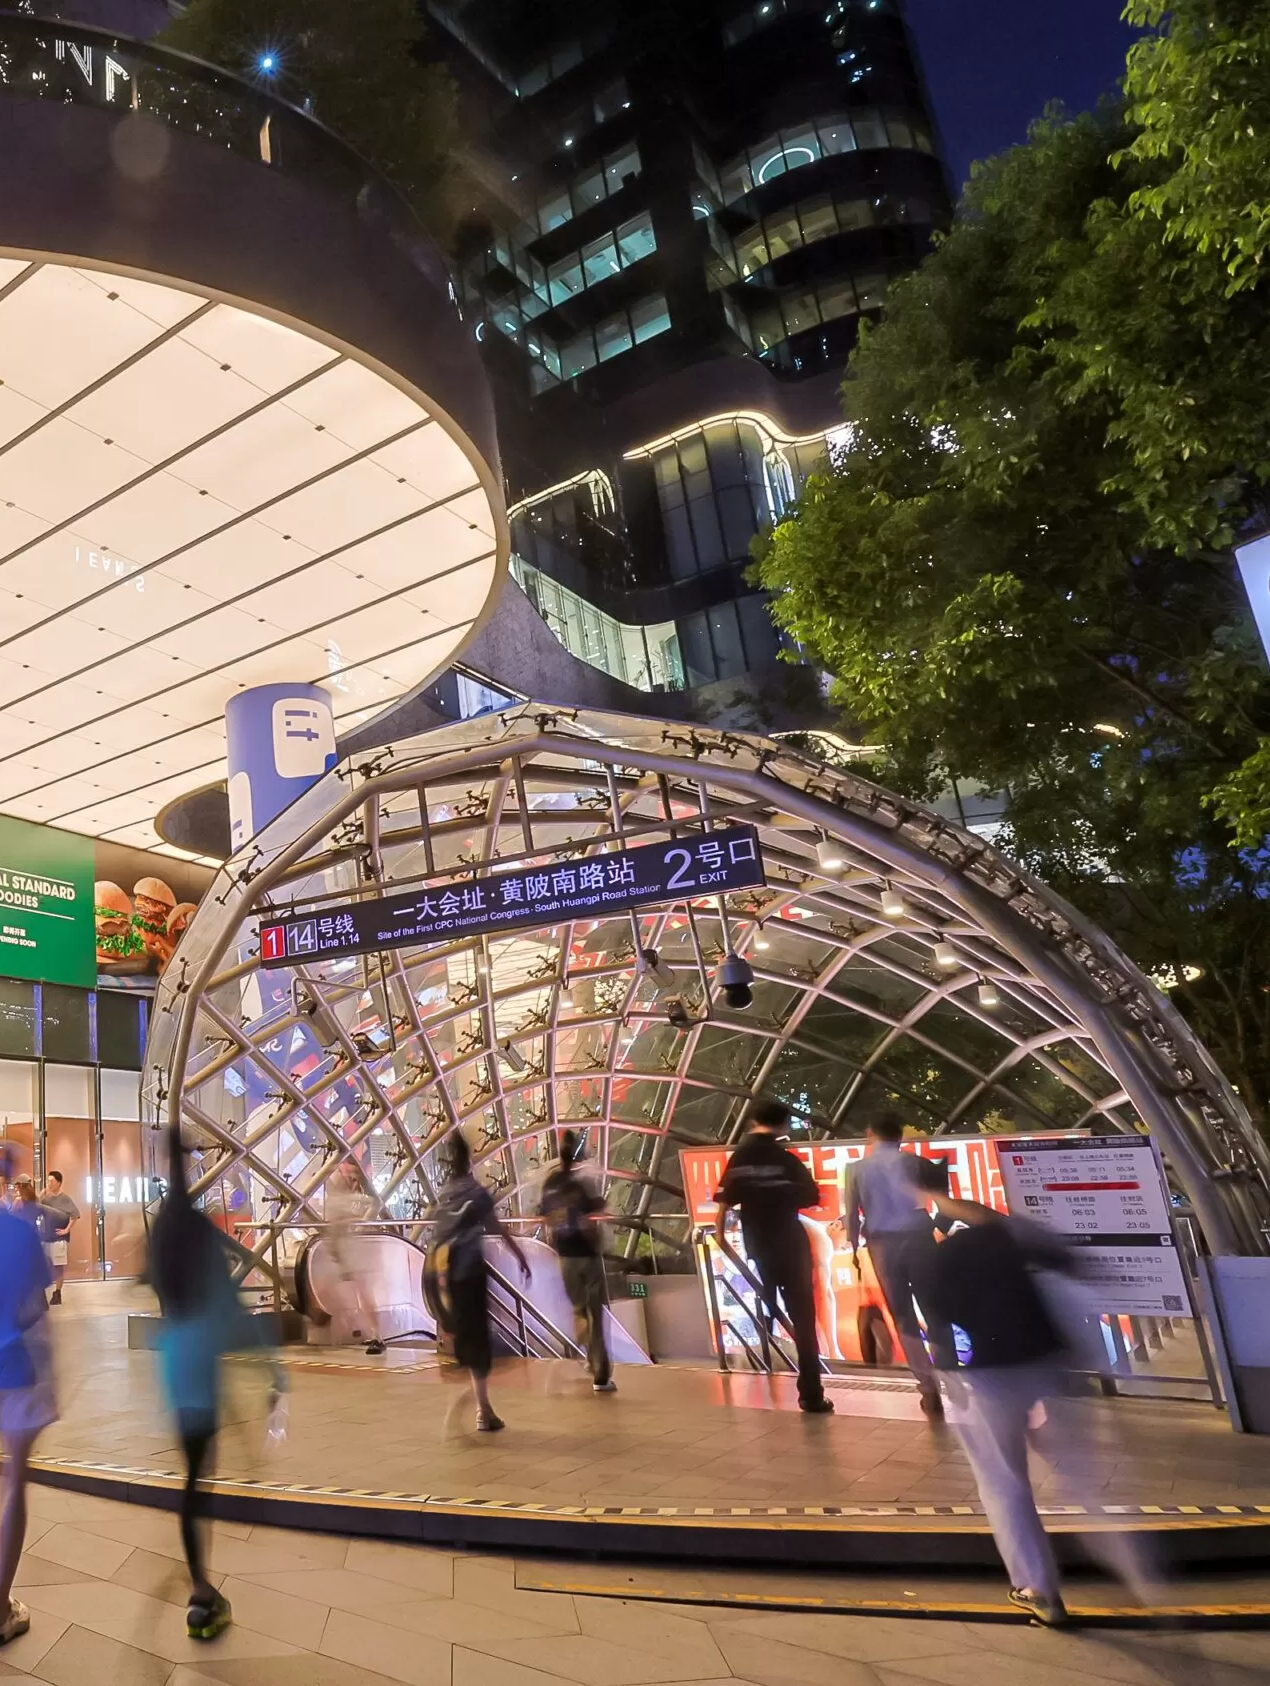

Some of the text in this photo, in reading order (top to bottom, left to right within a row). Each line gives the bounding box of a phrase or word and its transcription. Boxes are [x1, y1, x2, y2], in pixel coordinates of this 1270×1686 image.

[11, 875, 76, 901] STANDARD
[699, 869, 728, 885] EXIT
[377, 884, 662, 940] Site of the First CPC National Congress South Huangpi Road Station
[288, 923, 315, 951] 14
[318, 914, 354, 938] 号线
[19, 938, 37, 948] SOON
[266, 930, 278, 956] 1
[320, 936, 338, 949] Line
